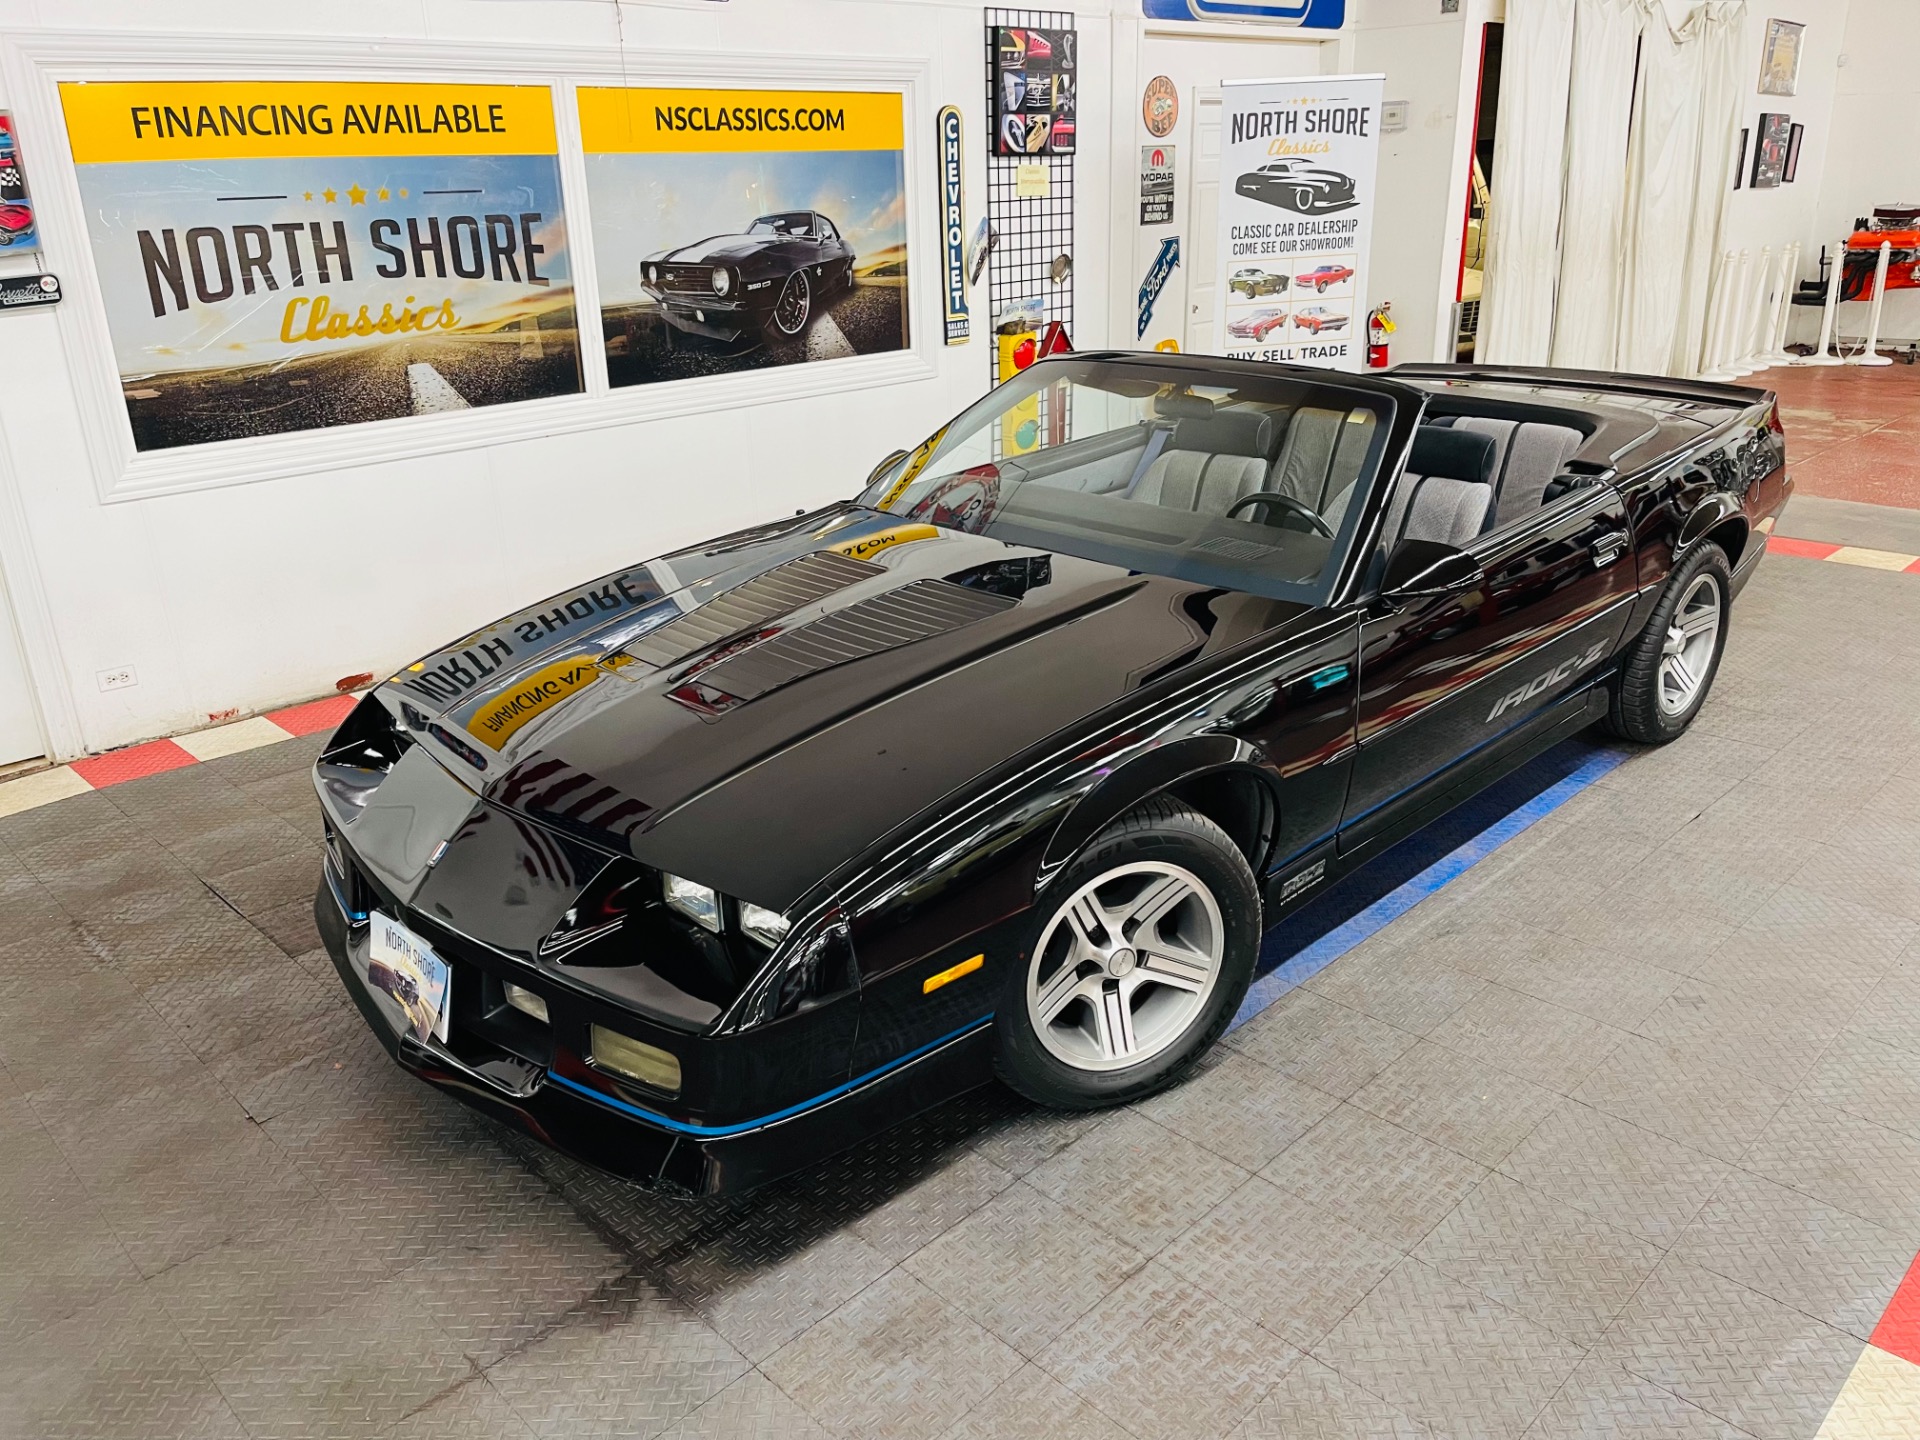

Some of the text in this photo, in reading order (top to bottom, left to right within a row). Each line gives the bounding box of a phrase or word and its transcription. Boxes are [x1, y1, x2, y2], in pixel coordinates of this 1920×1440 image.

[131, 103, 507, 139] FINANCING AVAILABLE
[655, 106, 845, 132] NSCLASSICS.COM
[1231, 107, 1371, 145] NORTH SHORE
[1267, 137, 1331, 156] Classics
[1141, 172, 1174, 182] MOPAR
[946, 118, 963, 310] CHEVROLET
[1231, 219, 1359, 240] CLASSIC CAR DEALERSHIP
[1232, 236, 1354, 256] COME SEE OUR SHOWROOM!
[138, 212, 551, 318] NORTH SHORE
[1146, 258, 1170, 300] Ford
[0, 282, 43, 300] orvette
[279, 295, 462, 344] Classics
[385, 927, 411, 960] NORTH
